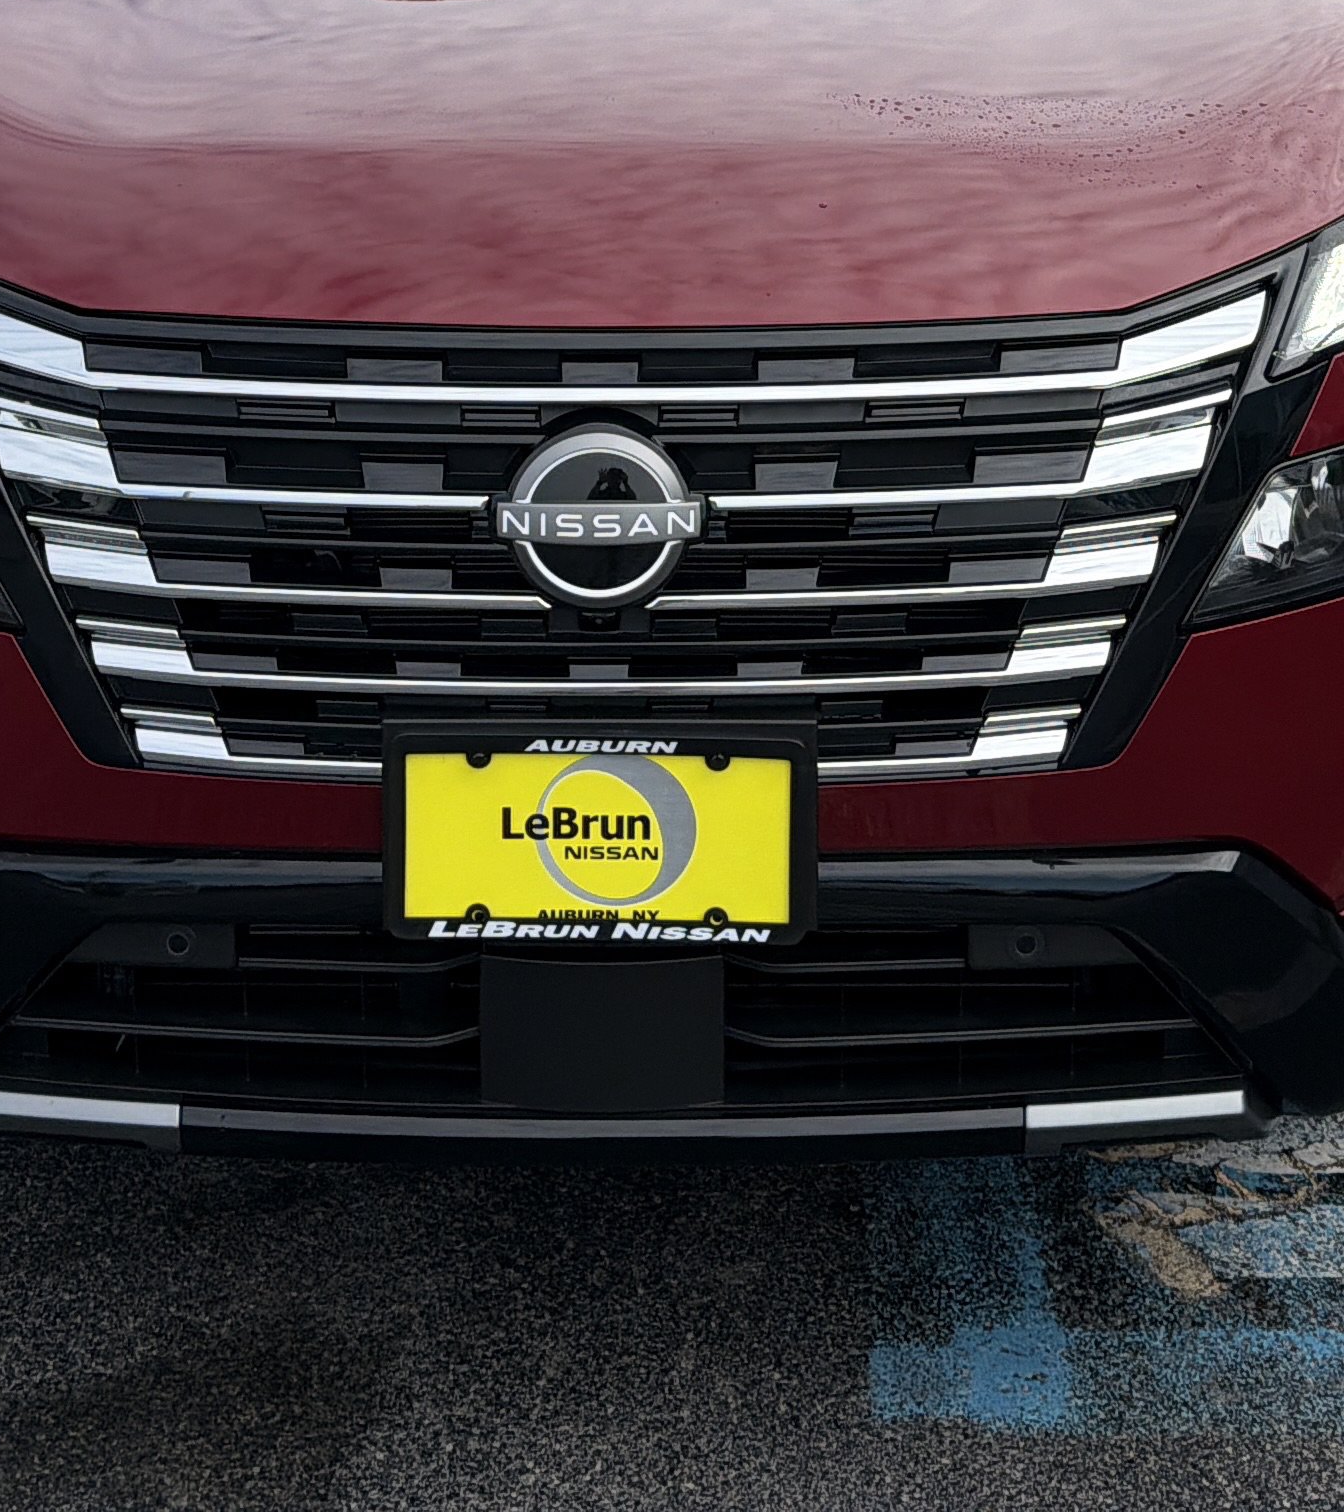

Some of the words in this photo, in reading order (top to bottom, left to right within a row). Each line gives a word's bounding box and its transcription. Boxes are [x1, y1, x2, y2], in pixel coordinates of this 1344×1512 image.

[501, 509, 696, 538] NISSAN
[523, 739, 679, 754] AUBURN
[501, 806, 652, 841] LeBrun
[564, 846, 659, 861] NISSAN
[632, 909, 660, 920] NY
[610, 923, 772, 943] NISSAN
